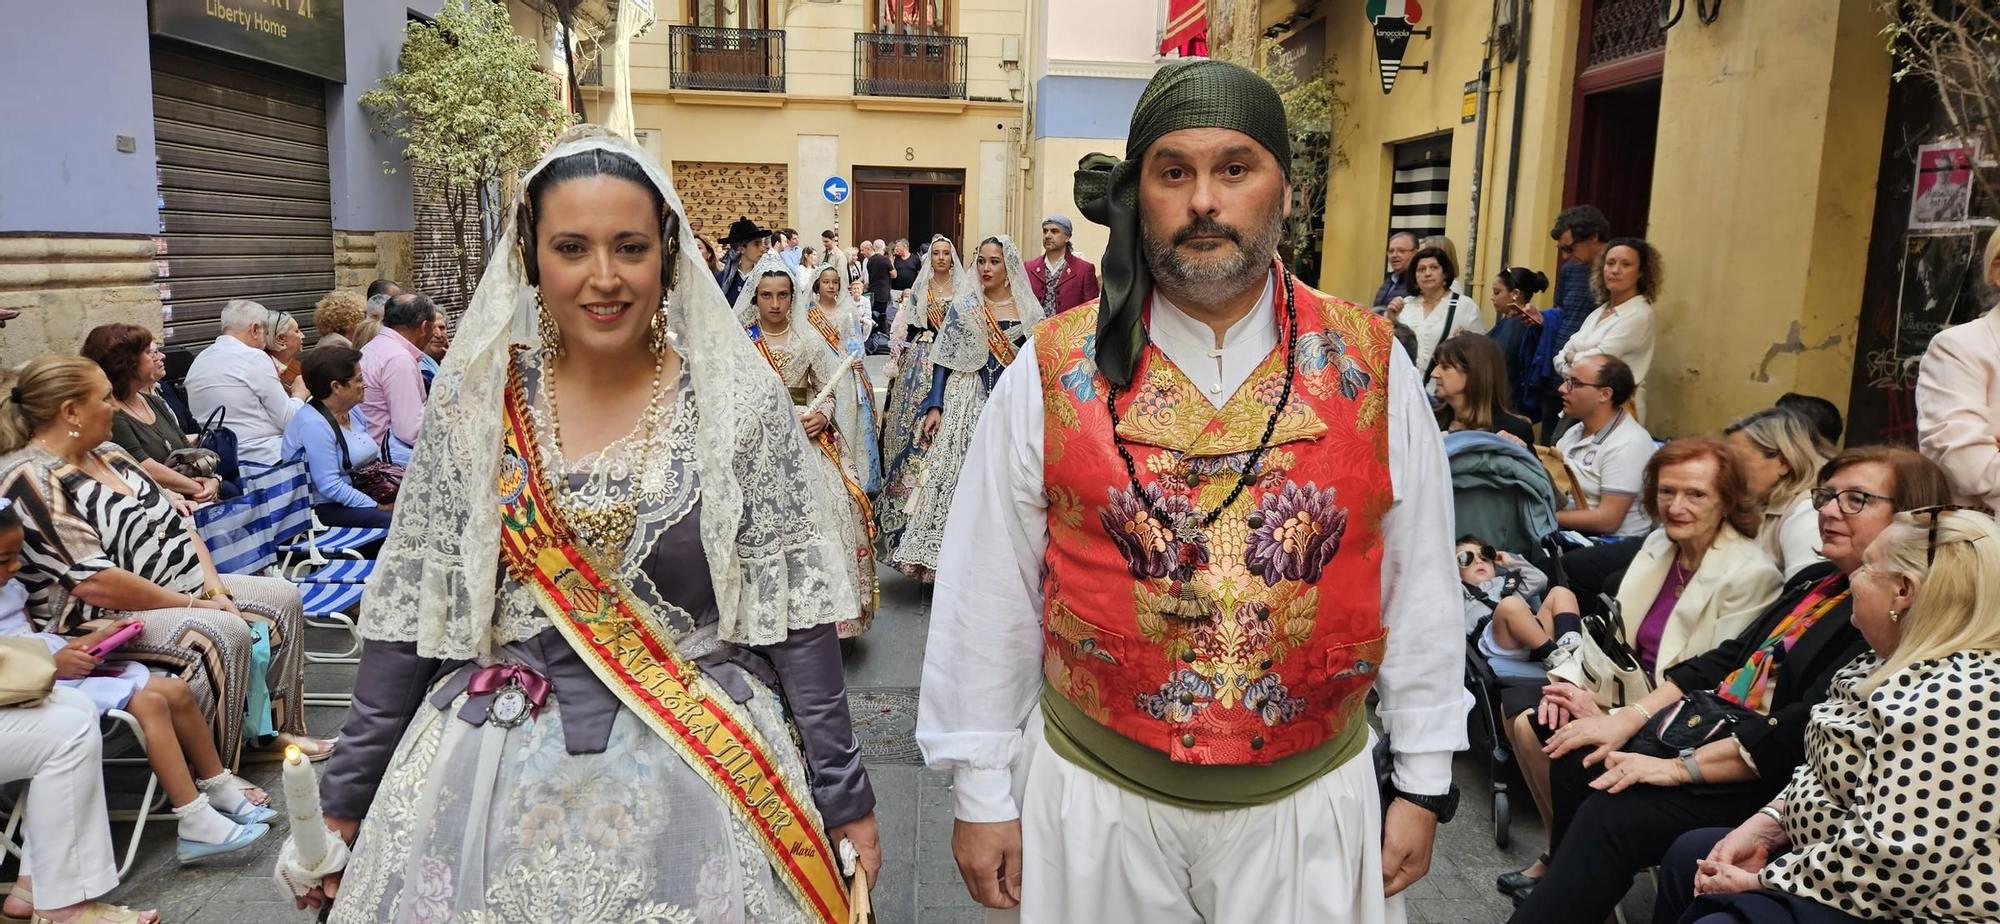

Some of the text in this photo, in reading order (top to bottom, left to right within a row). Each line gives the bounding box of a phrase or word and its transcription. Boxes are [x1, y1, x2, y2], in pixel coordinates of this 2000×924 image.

[206, 0, 288, 38] Liberty Home
[905, 146, 914, 161] 8
[592, 621, 793, 838] FALLERA MAJOR
